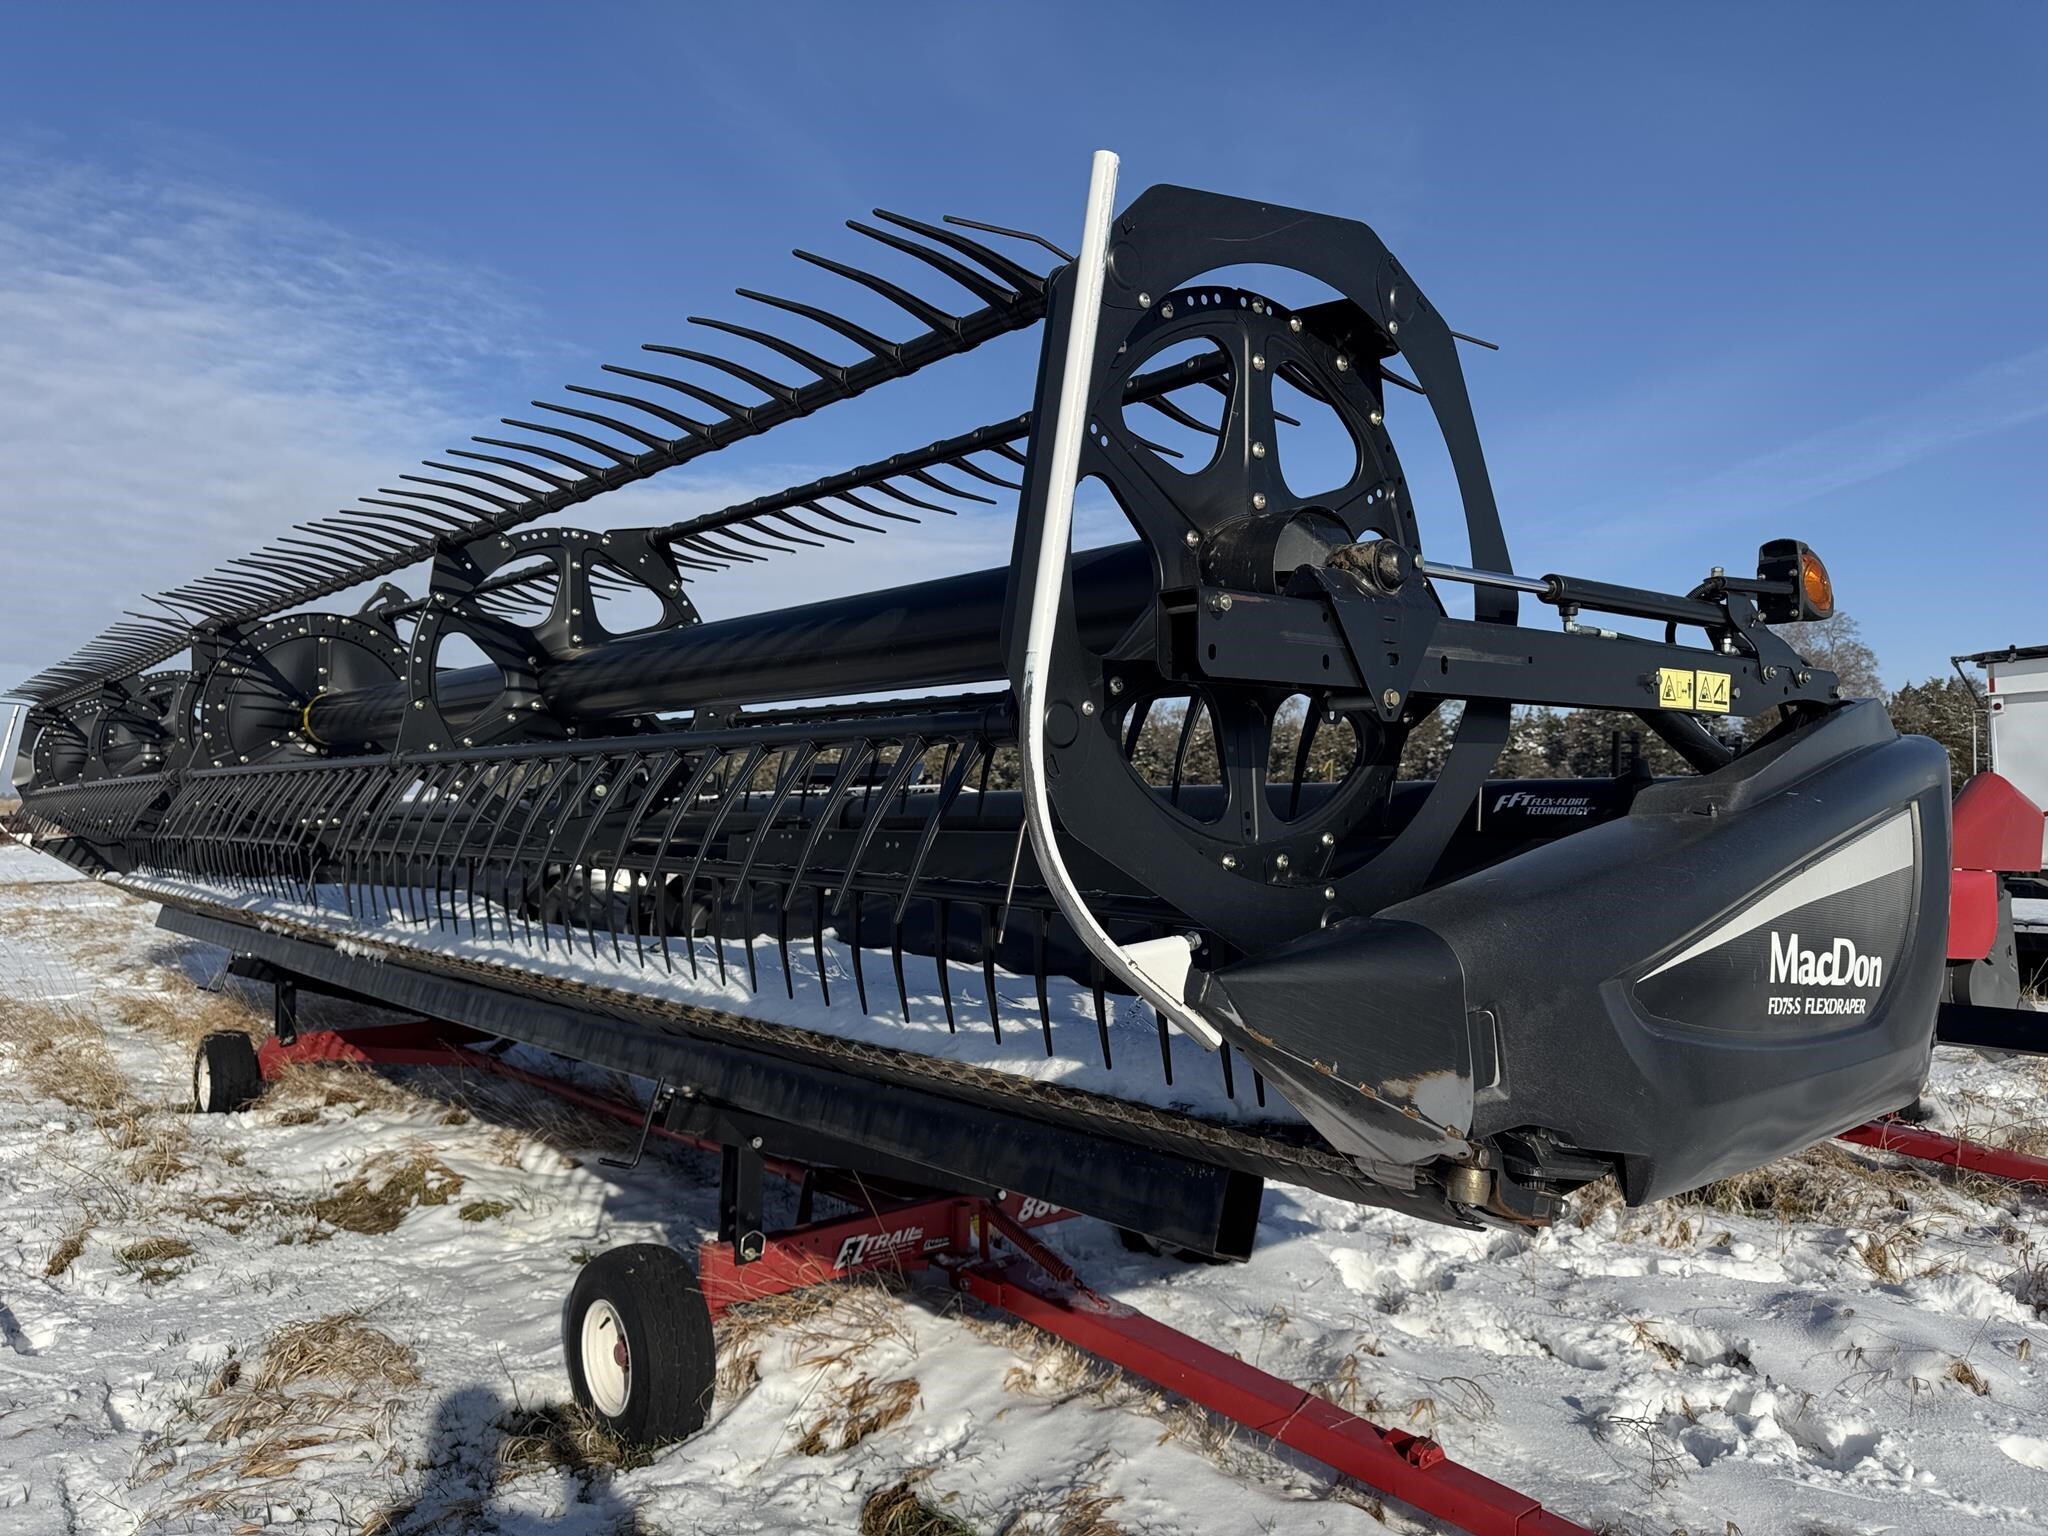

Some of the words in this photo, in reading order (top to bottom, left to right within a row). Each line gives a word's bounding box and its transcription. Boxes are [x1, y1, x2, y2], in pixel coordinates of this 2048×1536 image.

[1769, 931, 1882, 987] MacDon
[1768, 997, 1801, 1015] FD75-S
[1804, 997, 1866, 1014] FLEXDRAPER
[864, 1226, 923, 1252] TRAIL
